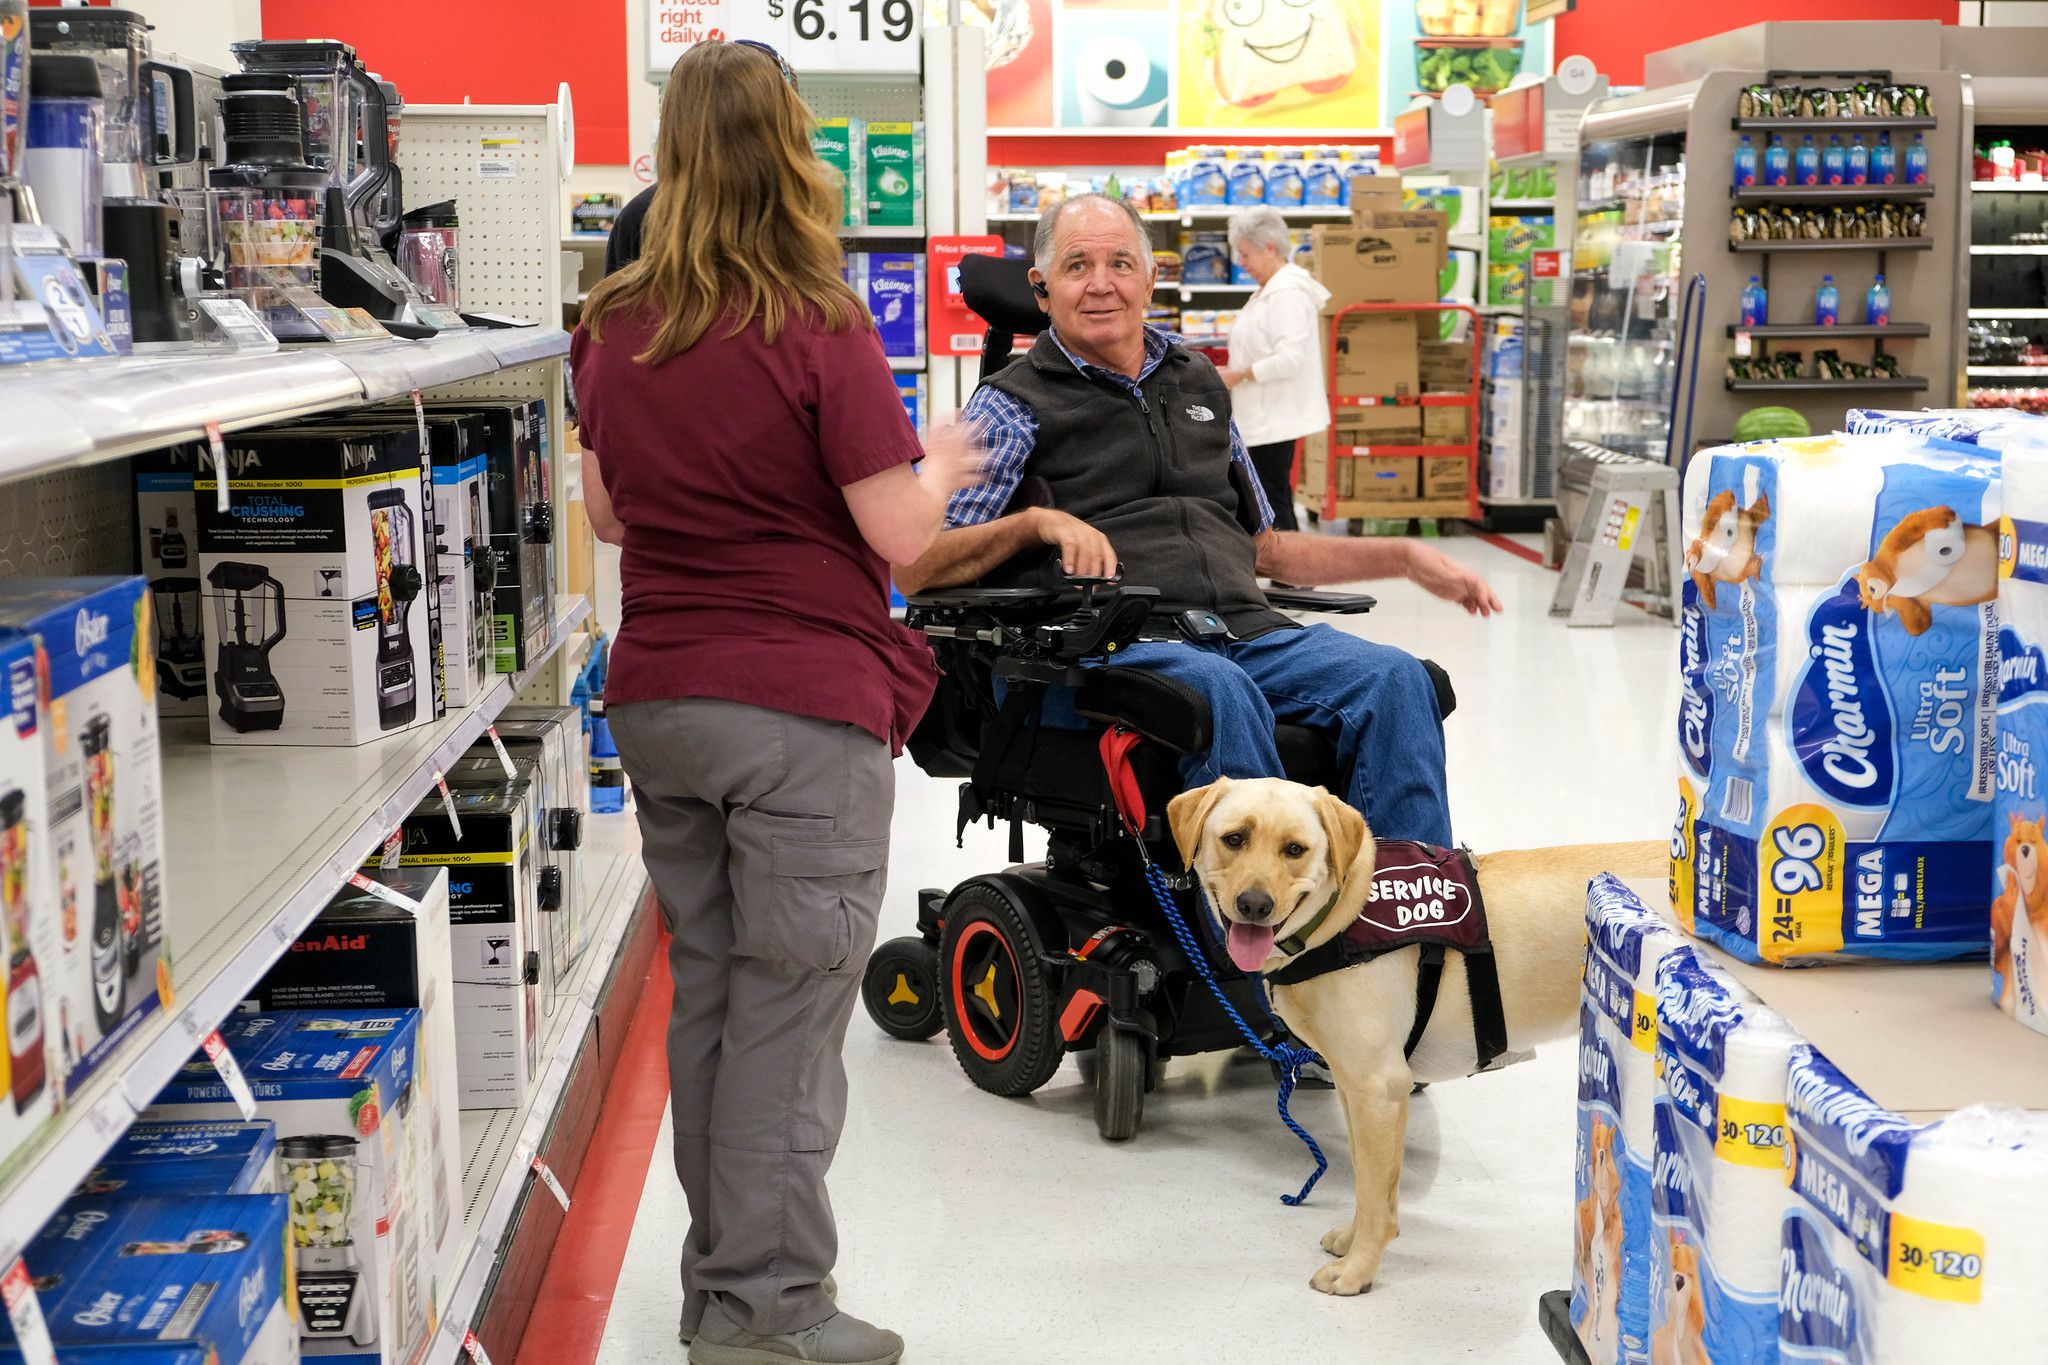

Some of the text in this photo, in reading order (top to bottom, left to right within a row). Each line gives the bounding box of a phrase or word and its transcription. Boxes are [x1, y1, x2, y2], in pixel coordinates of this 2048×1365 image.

[660, 8, 702, 27] right
[661, 28, 702, 47] daily
[871, 144, 910, 159] Kleenex
[935, 245, 997, 254] Price Scanner
[872, 278, 913, 294] Kleenex
[198, 444, 262, 476] NNJA
[342, 443, 377, 472] NINJA
[231, 505, 305, 517] CRUSHING
[248, 496, 287, 506] TOTAL
[2000, 533, 2012, 561] 20
[2019, 543, 2048, 569] MEG
[421, 426, 446, 720] PROFESSIONAL
[75, 608, 109, 657] Oster
[1723, 633, 1742, 705] Soft
[2000, 647, 2037, 688] armin
[1811, 623, 1878, 789] Charmin
[1911, 682, 1933, 740] Ultra
[1930, 667, 1968, 755] Soft
[2003, 729, 2030, 756] Ultra
[1978, 739, 1989, 794] IRRESISTIBLY
[1997, 752, 2036, 800] Soft
[1367, 875, 1456, 902] SERVICE
[1698, 830, 1712, 916] MEGA
[1855, 848, 1885, 937] MEGA
[1914, 856, 1925, 929] ROLLS/ROULEAUX
[1397, 898, 1445, 926] DOG
[261, 1051, 296, 1071] Oster
[188, 1083, 283, 1098] POWERFU TURES
[1802, 1153, 1850, 1223] MEGA
[73, 1290, 123, 1326] Oster
[1779, 1246, 1849, 1340] Charmin
